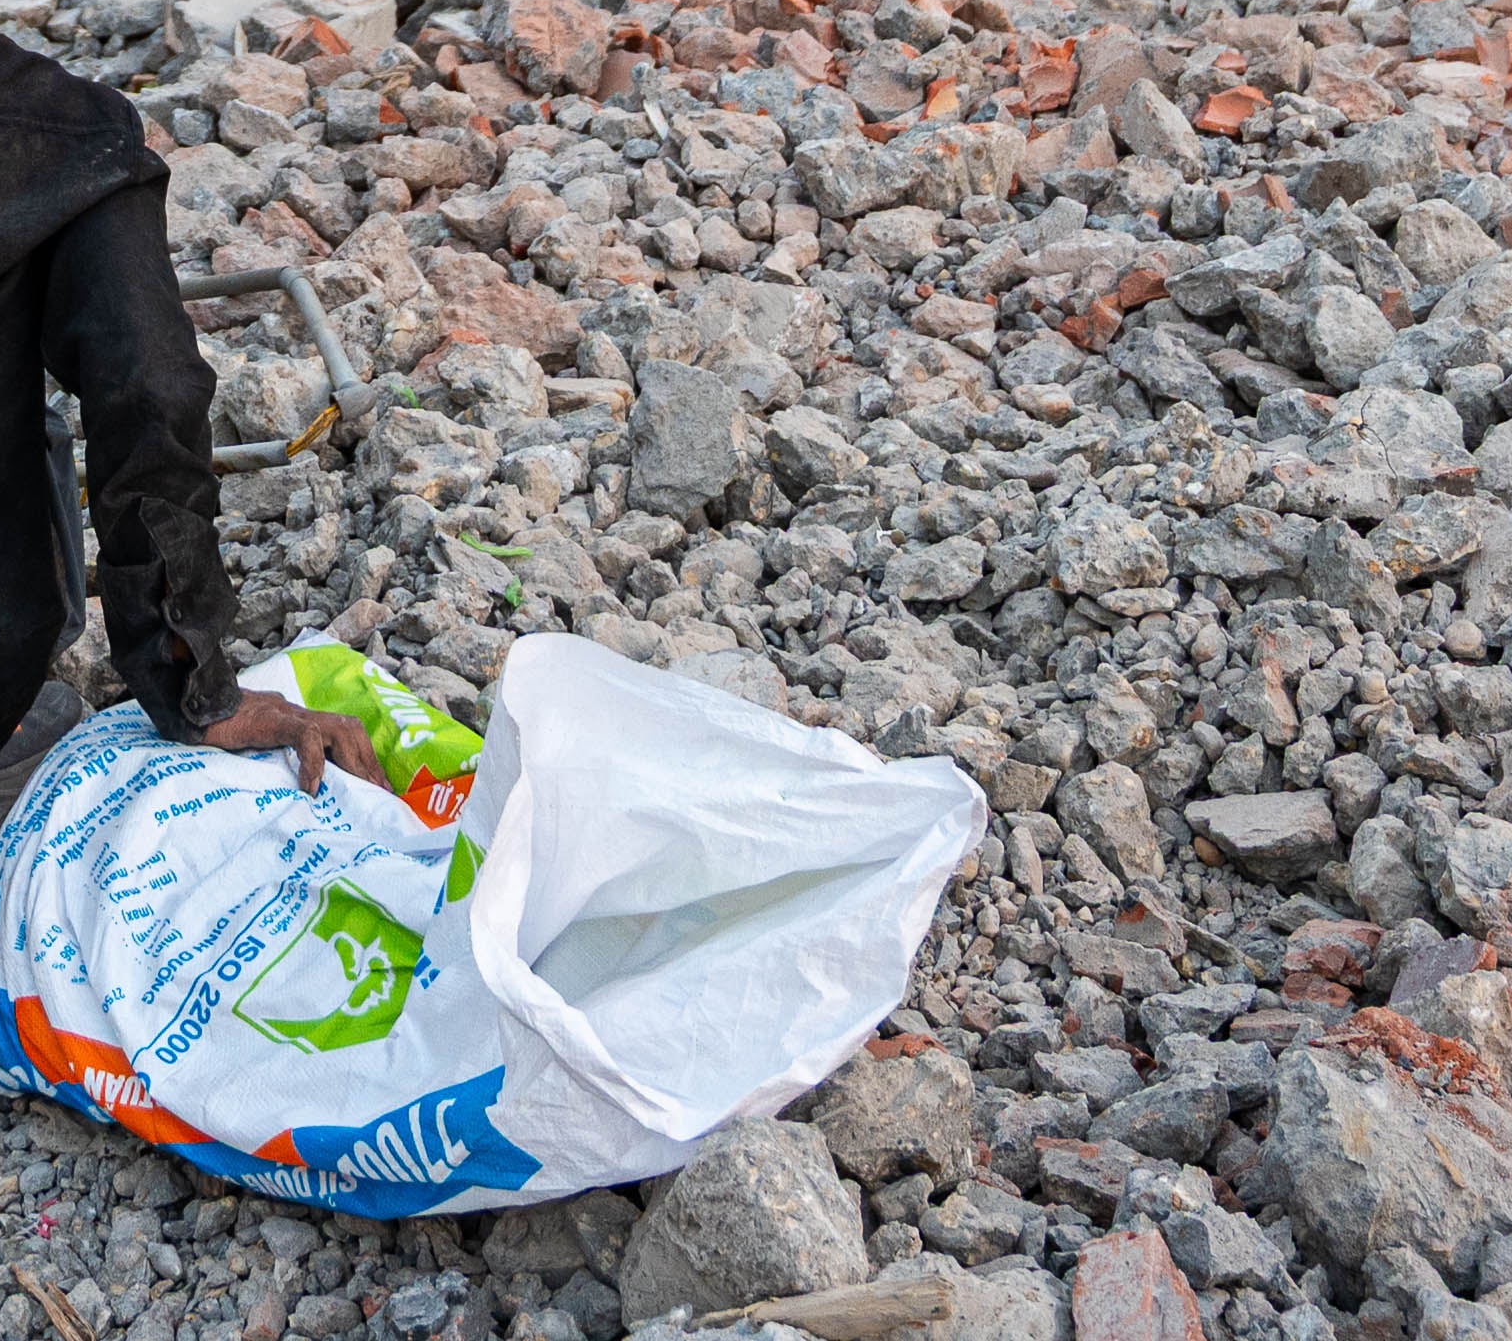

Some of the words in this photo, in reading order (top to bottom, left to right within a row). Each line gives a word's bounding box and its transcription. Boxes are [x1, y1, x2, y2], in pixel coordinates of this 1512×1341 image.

[134, 759, 206, 794] NGUYÊN
[149, 868, 178, 892] (min
[121, 903, 155, 925] (max)
[193, 917, 231, 954] DINH
[217, 935, 266, 982] ISO
[154, 981, 221, 1065] 22000
